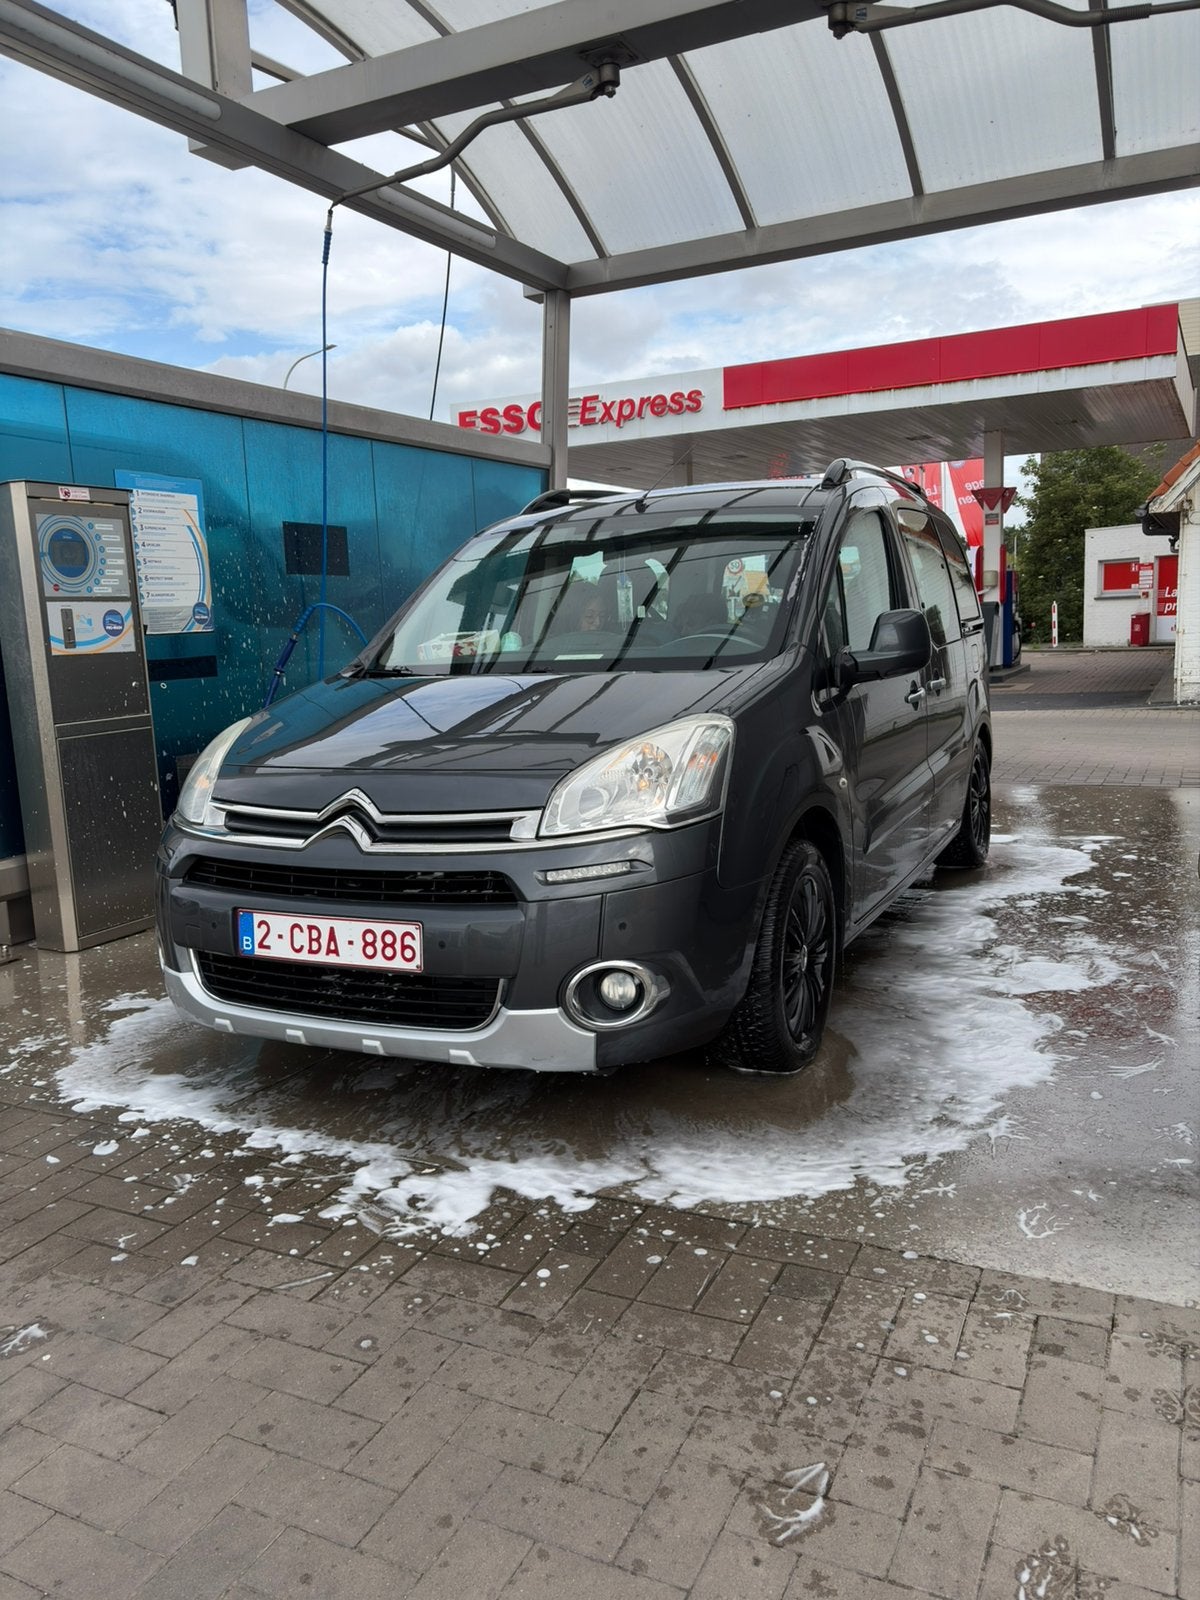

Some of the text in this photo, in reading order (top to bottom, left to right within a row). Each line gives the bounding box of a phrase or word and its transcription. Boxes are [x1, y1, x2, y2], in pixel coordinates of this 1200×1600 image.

[579, 388, 703, 429] Express
[243, 920, 417, 963] B 2-CBA-886
